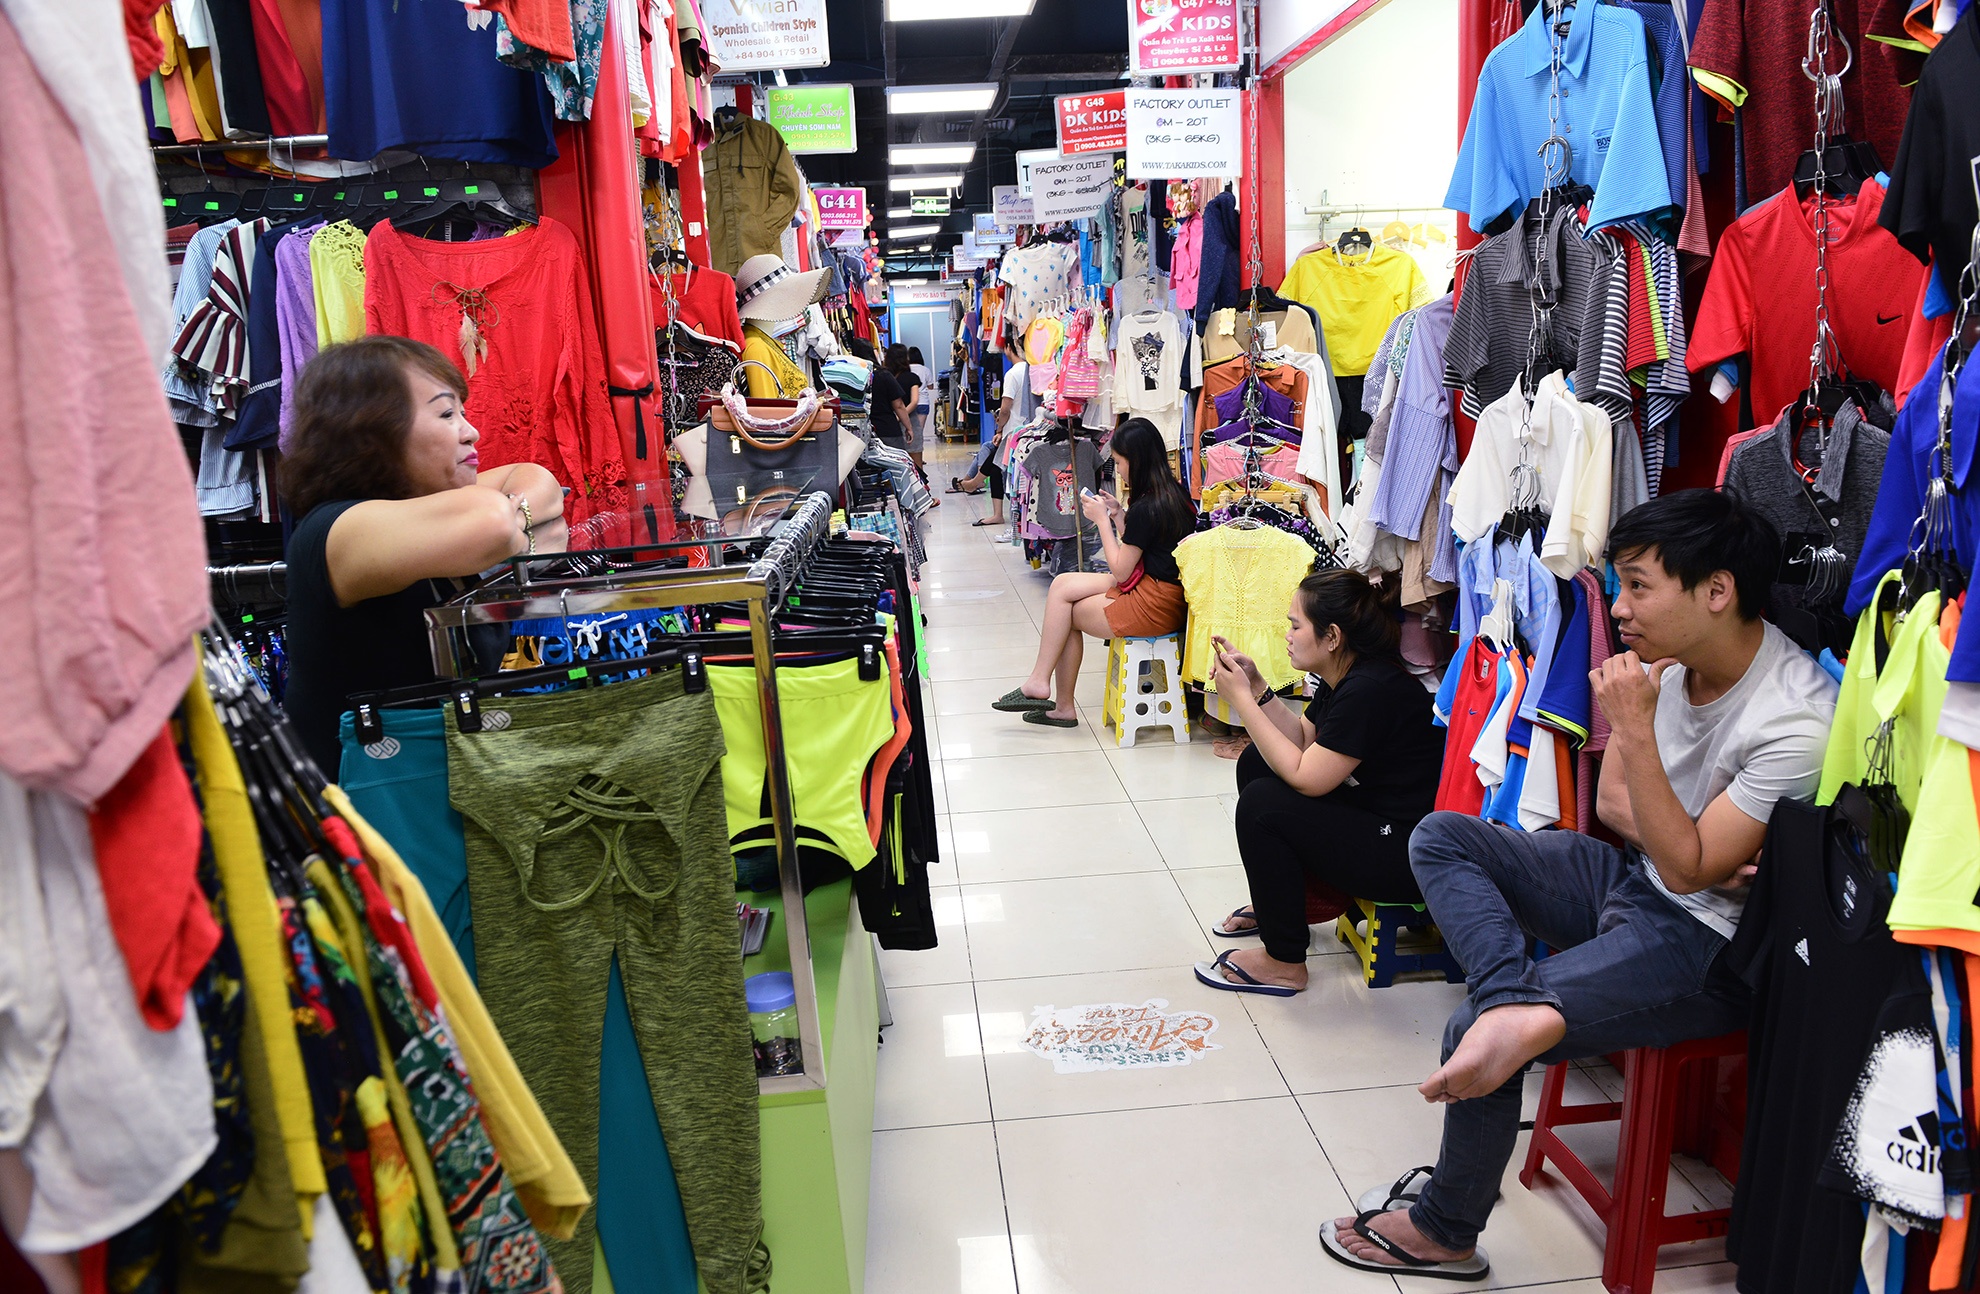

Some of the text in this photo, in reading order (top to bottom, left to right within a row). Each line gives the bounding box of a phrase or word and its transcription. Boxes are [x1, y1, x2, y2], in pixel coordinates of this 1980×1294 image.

[730, 0, 798, 16] Vivian
[712, 18, 816, 38] Spanish Children Style
[1182, 15, 1232, 31] KIDS
[724, 34, 810, 47] Wholesale & Retail
[735, 46, 818, 60] +84 904 175 913
[773, 93, 794, 102] G.43
[1085, 97, 1105, 107] G48
[1133, 99, 1231, 109] FACTORY OUTLET
[816, 102, 846, 122] Shop
[1064, 108, 1127, 127] DK KIDS
[1035, 160, 1107, 175] FACTORY OUTLET
[1141, 161, 1227, 169] WWW.TAKAKIDS.COM
[820, 194, 857, 209] G44
[1044, 204, 1102, 216] WWW.TAKAKIDS.CO
